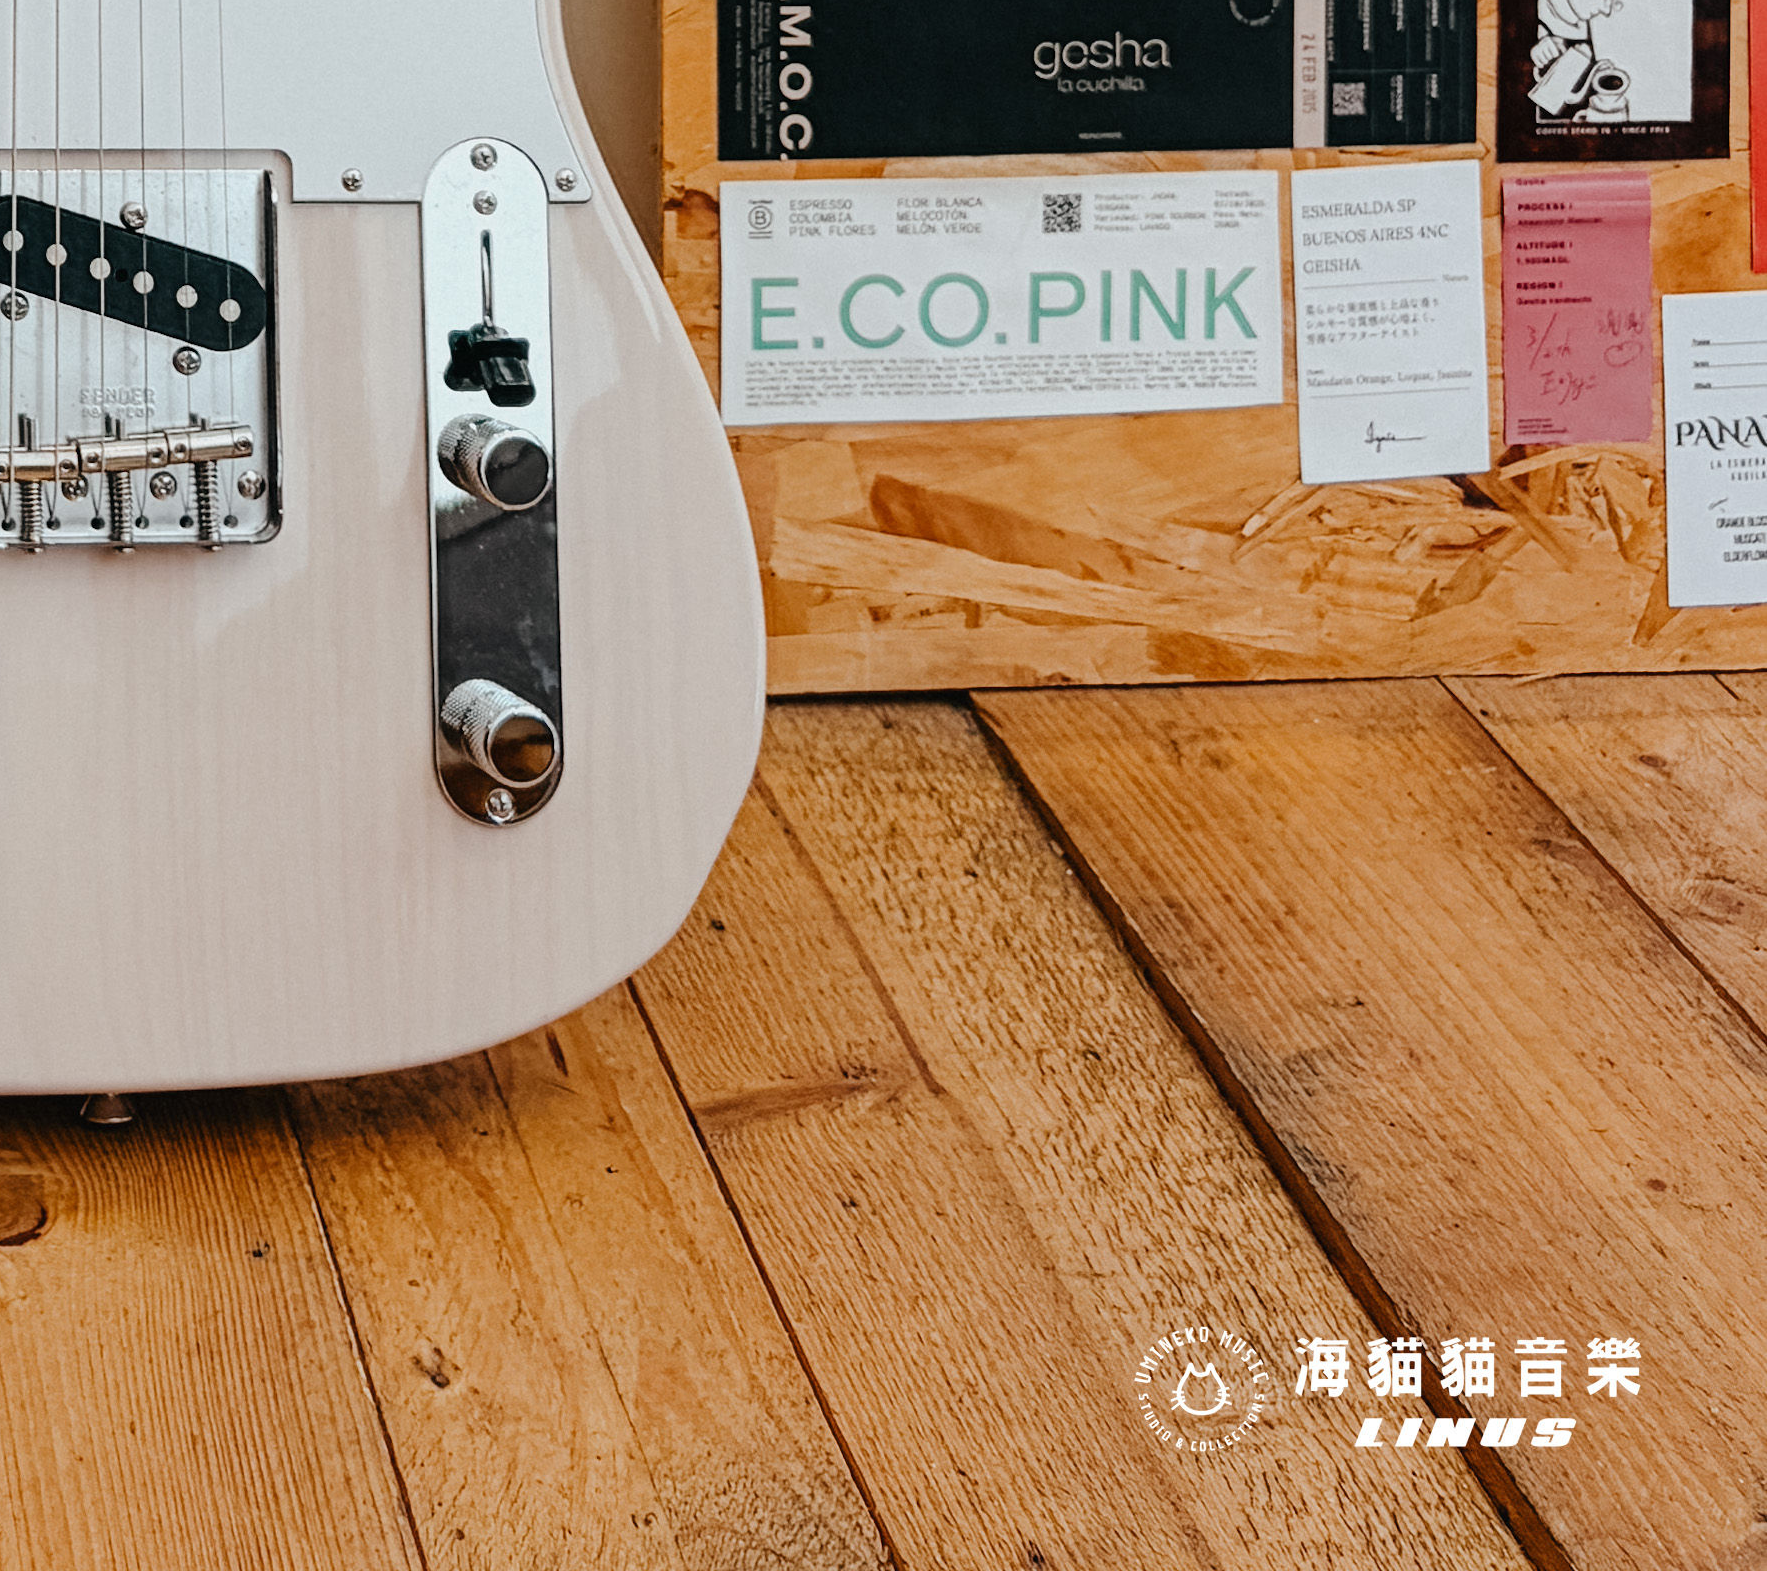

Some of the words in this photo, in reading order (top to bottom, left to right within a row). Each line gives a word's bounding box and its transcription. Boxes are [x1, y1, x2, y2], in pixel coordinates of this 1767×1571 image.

[1034, 31, 1172, 80] gesha
[1301, 57, 1317, 84] FEB
[789, 199, 853, 211] ESPRESSO
[897, 197, 930, 208] FLOR
[935, 196, 984, 207] BLANCA
[1302, 200, 1394, 219] ESMERALDA
[1397, 199, 1416, 212] SP
[789, 211, 853, 224] COLOMBIA
[1303, 228, 1366, 246] BUENOS
[1369, 225, 1414, 242] AIRES
[1303, 257, 1361, 274] GEISHA
[750, 267, 1259, 351] E.CO.PINK
[1675, 415, 1767, 451] PANA
